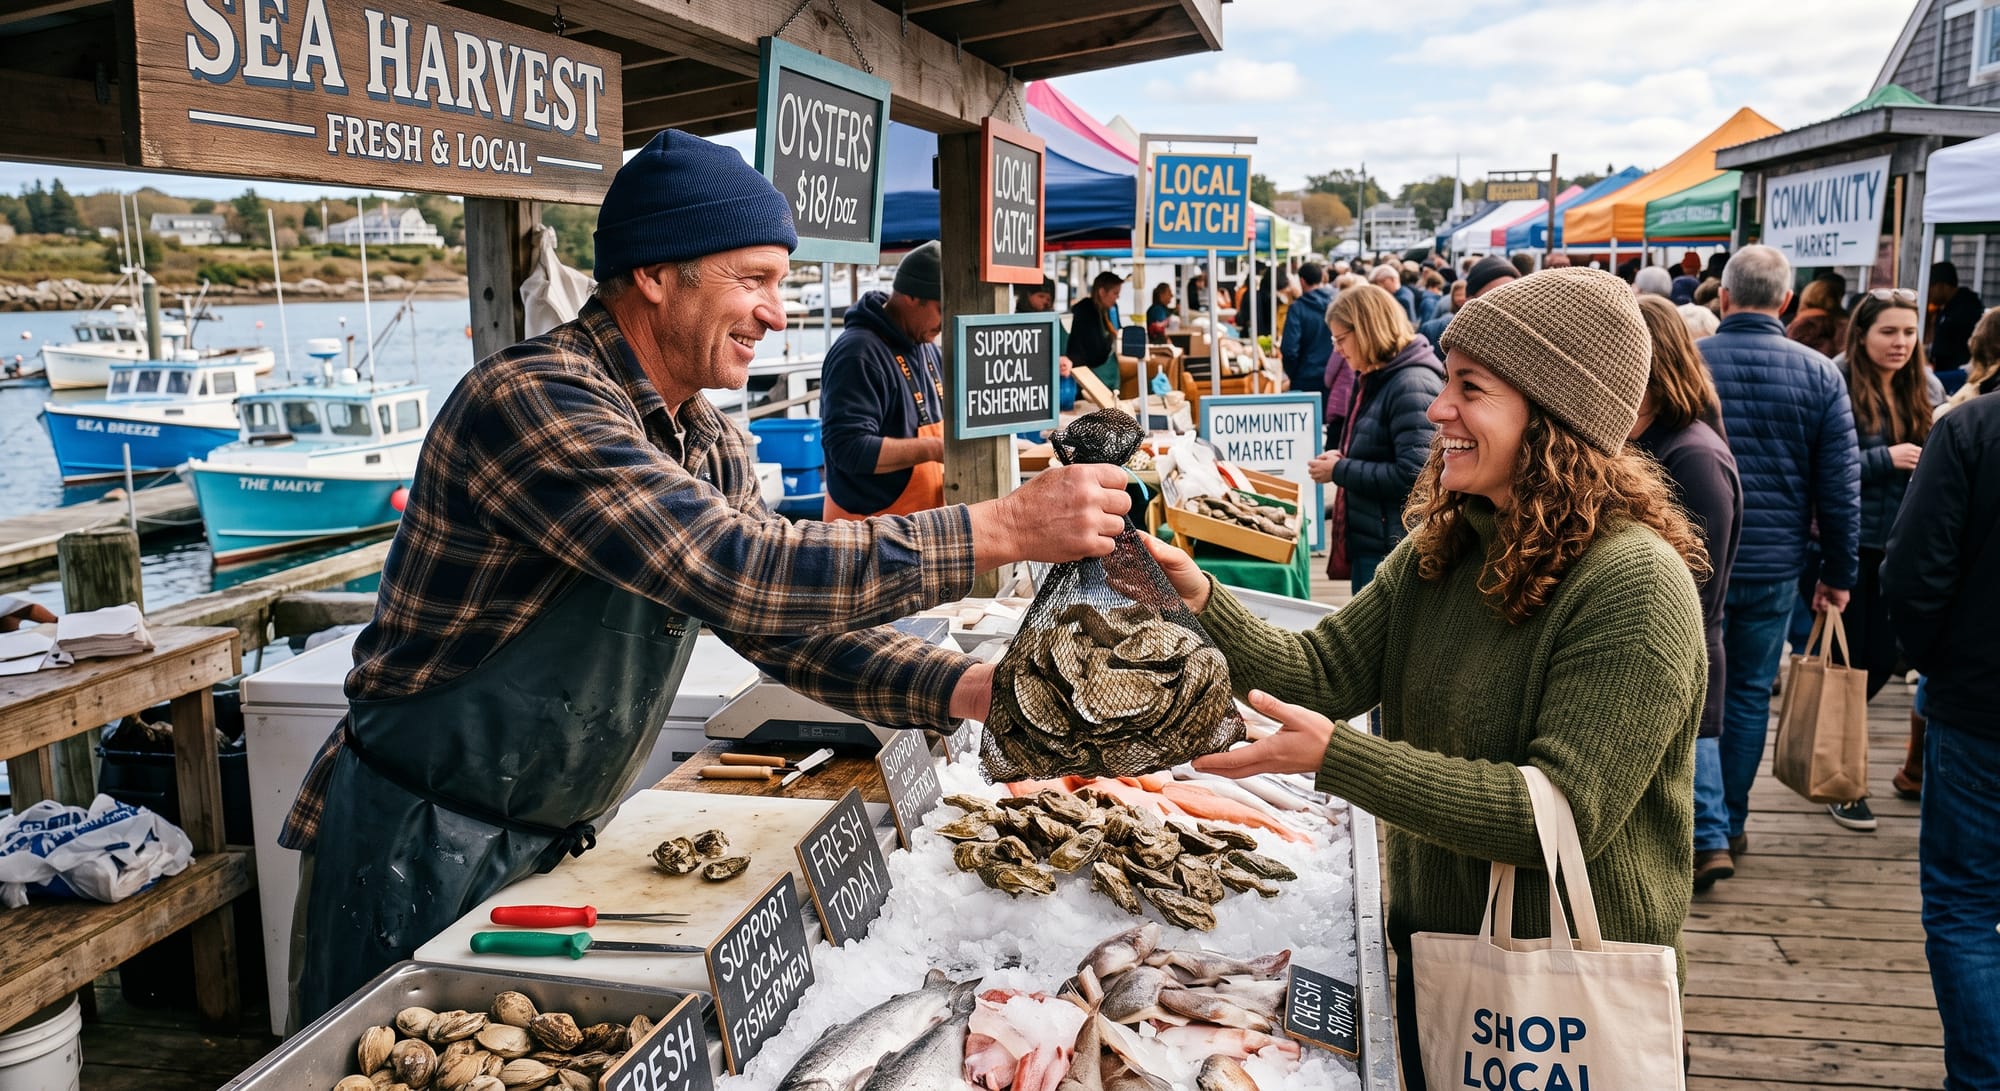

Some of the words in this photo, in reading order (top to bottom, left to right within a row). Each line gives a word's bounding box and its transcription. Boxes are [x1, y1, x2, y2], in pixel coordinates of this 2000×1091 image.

[187, 0, 346, 92] SEA
[365, 9, 604, 138] HARVEST
[327, 114, 422, 163] FRESH
[431, 130, 449, 165] &
[457, 133, 532, 174] LOCAL
[779, 93, 873, 173] OYSTERS
[995, 154, 1036, 206] LOCAL
[1160, 163, 1241, 196] LOCAL
[1771, 170, 1881, 230] COMMUNITY
[993, 207, 1035, 256] CATCH
[1158, 200, 1240, 234] CATCH
[1794, 232, 1840, 257] MARKET
[974, 329, 1042, 357] SUPPORT
[985, 358, 1033, 385] LOCAL
[968, 384, 1049, 417] FISHERMEN
[1215, 412, 1308, 435] COMMUNITY
[76, 418, 104, 433] SEA
[107, 422, 161, 438] BREEZE
[1228, 439, 1295, 462] MARKET
[239, 477, 269, 491] THE
[272, 479, 326, 494] MAEVE
[810, 805, 867, 887] FRESH
[828, 850, 882, 932] TODAY
[719, 885, 789, 982] SUPPORT
[741, 936, 789, 1003] LOCAL
[733, 945, 810, 1059] FISHERMEN
[1472, 1008, 1587, 1053] SHOP
